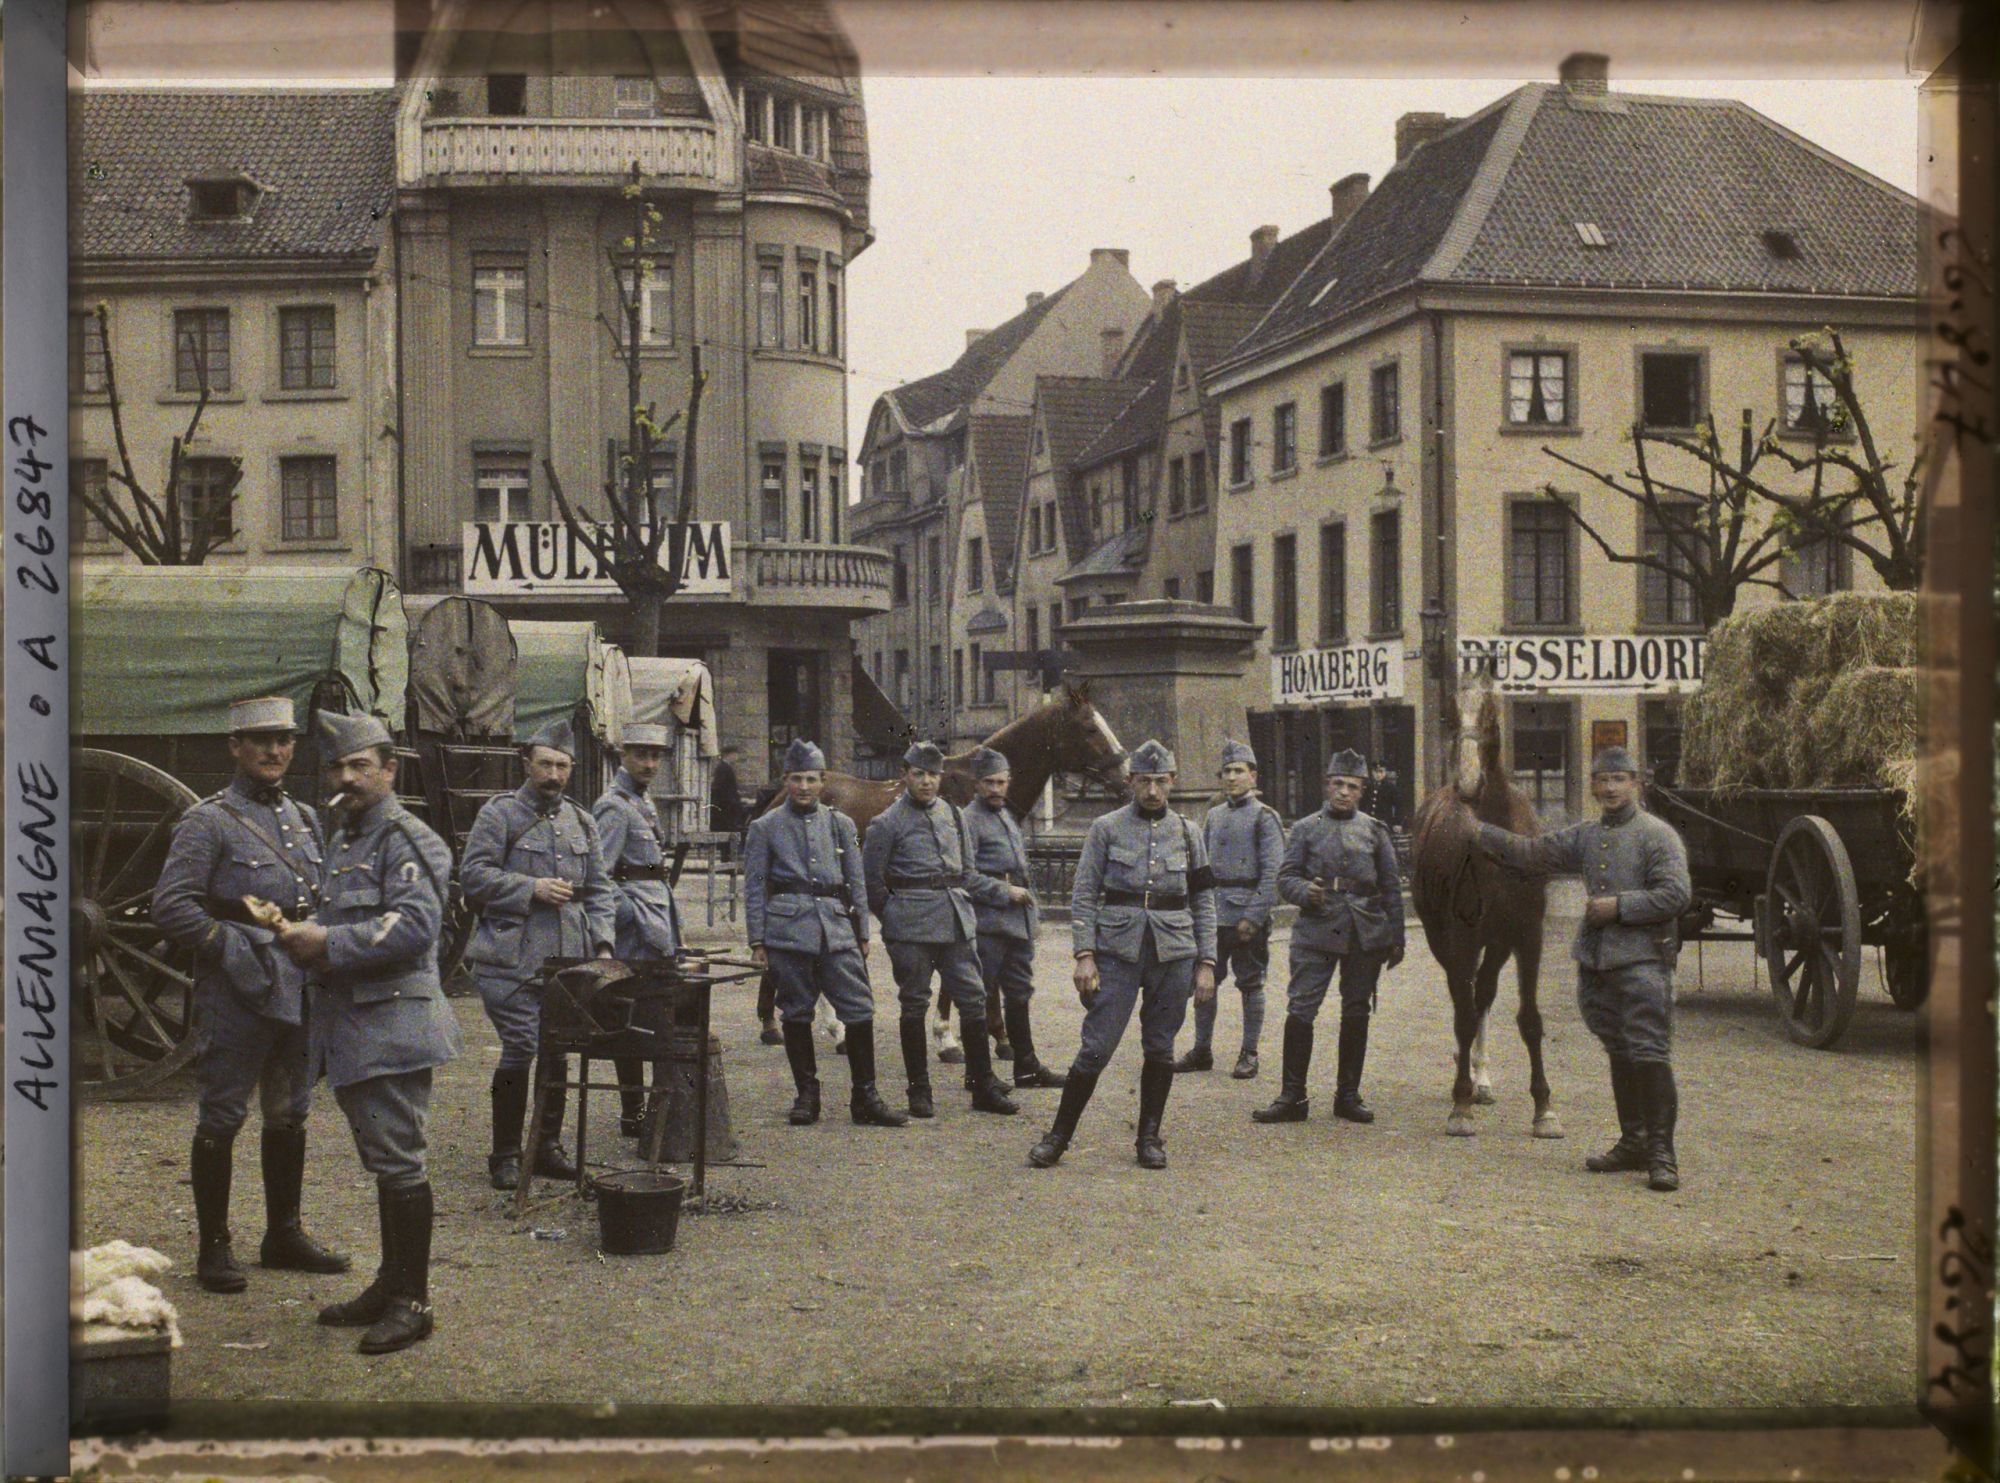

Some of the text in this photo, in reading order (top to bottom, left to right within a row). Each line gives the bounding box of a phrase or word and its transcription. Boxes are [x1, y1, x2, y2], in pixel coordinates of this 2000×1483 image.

[468, 523, 730, 580] MÜLHIM
[1281, 647, 1388, 694] HOMBERG
[9, 414, 60, 1111] ALLEMAGNE A 26847
